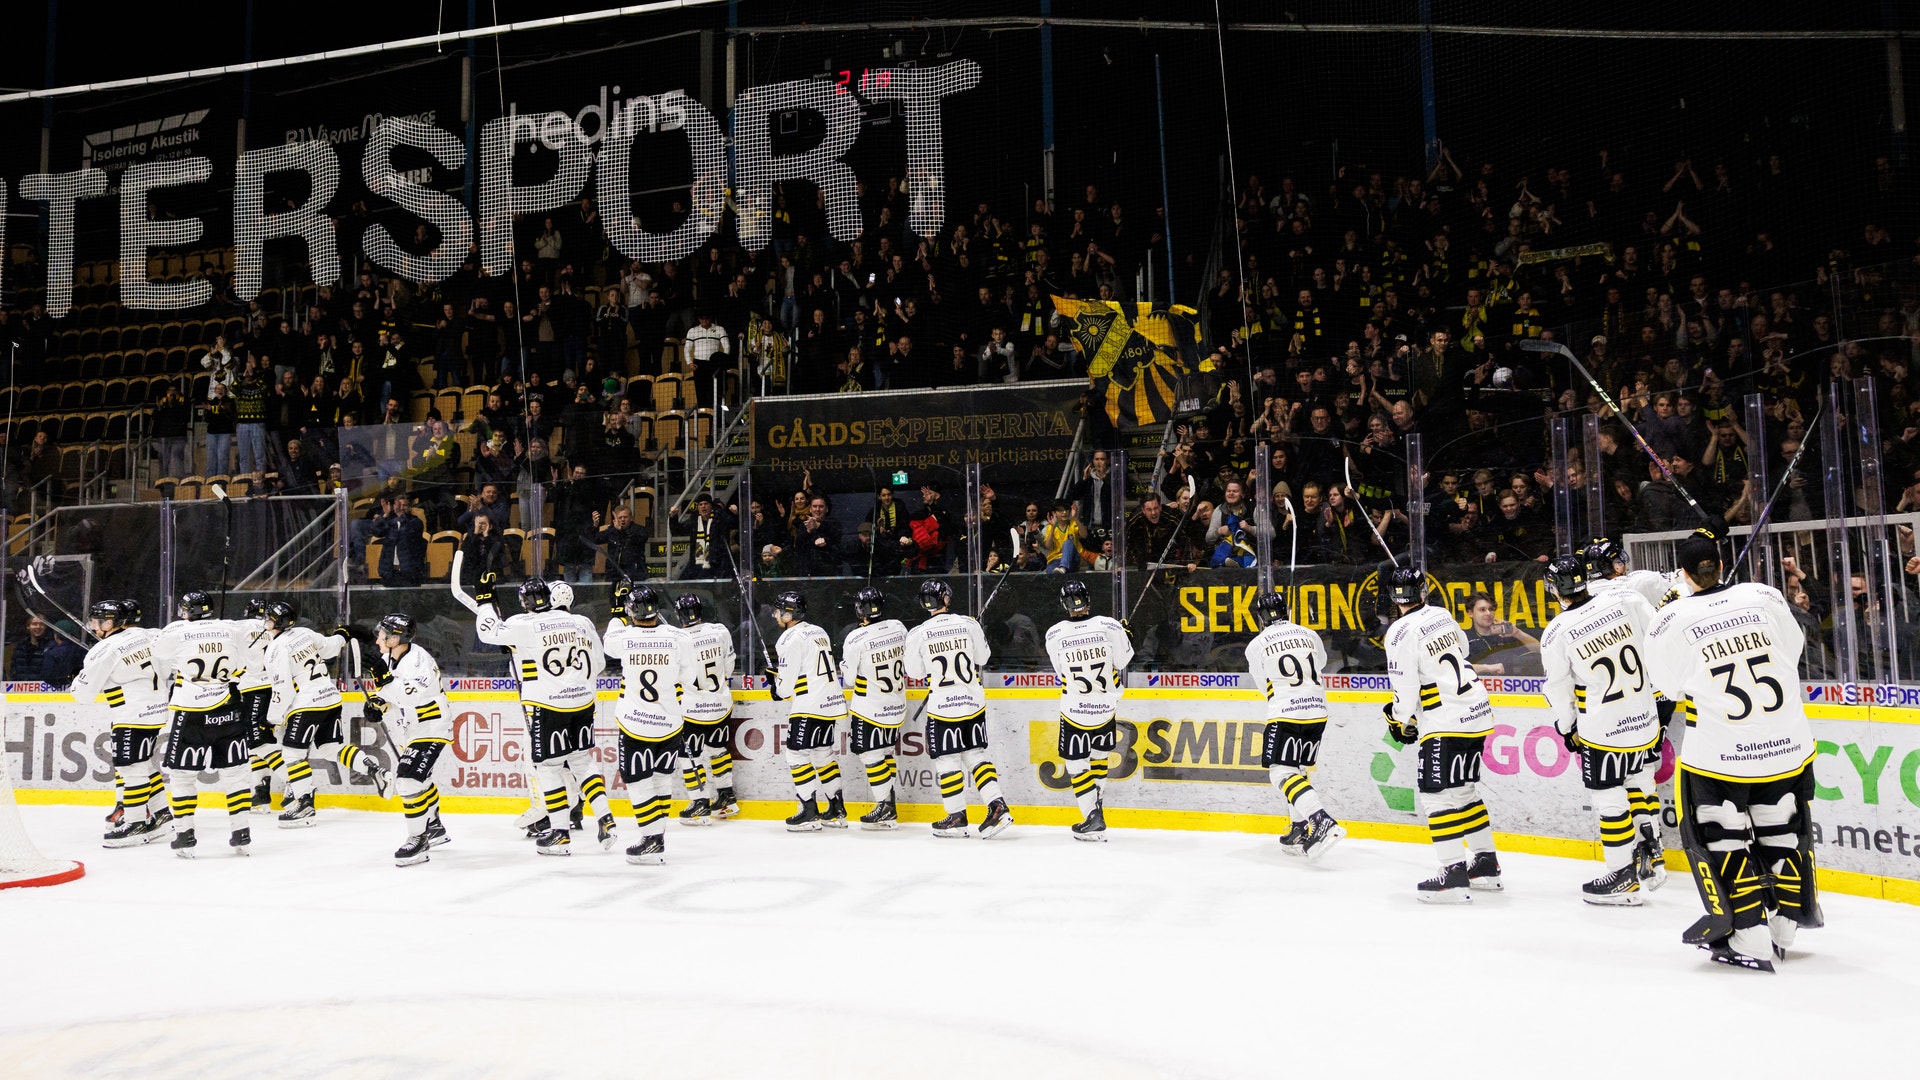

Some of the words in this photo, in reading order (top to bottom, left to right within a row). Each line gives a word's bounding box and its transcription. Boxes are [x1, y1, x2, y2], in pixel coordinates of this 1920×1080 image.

[510, 85, 686, 156] hedins
[93, 141, 147, 162] Isolering
[150, 128, 200, 150] Akustik
[771, 457, 843, 473] Prisvärda
[847, 453, 944, 470] Dräneringar
[948, 449, 961, 465] &
[1179, 583, 1358, 634] SEKION
[1708, 599, 1729, 607] CCM
[184, 629, 230, 641] Bemannia
[926, 625, 968, 639] Bemannia
[1568, 608, 1624, 640] Bemannia
[1691, 611, 1762, 639] Bemannia
[198, 642, 223, 654] NORD
[627, 639, 673, 649] Bemannia
[928, 636, 968, 655] RUDSLÄTT
[1061, 634, 1104, 648] Bemannia
[1065, 646, 1107, 663] SJÖBERG
[1576, 622, 1634, 661] LJUNGMAN
[1701, 631, 1772, 663] STÅLBERG
[187, 655, 231, 683] 26
[629, 653, 670, 666] HEDBERG
[931, 651, 973, 687] 20
[1277, 651, 1321, 688] 91
[140, 660, 158, 691] 7
[639, 669, 659, 703] 8
[1069, 661, 1107, 695] 53
[1160, 674, 1240, 688] INTERSPORT
[1590, 644, 1645, 704] 29
[1709, 653, 1784, 721] 35
[205, 711, 234, 726] kopal
[1719, 743, 1802, 762] Emballagehantering
[1735, 736, 1791, 753] Sollentuna
[1610, 878, 1633, 894] CCM
[1697, 860, 1724, 916] CCM
